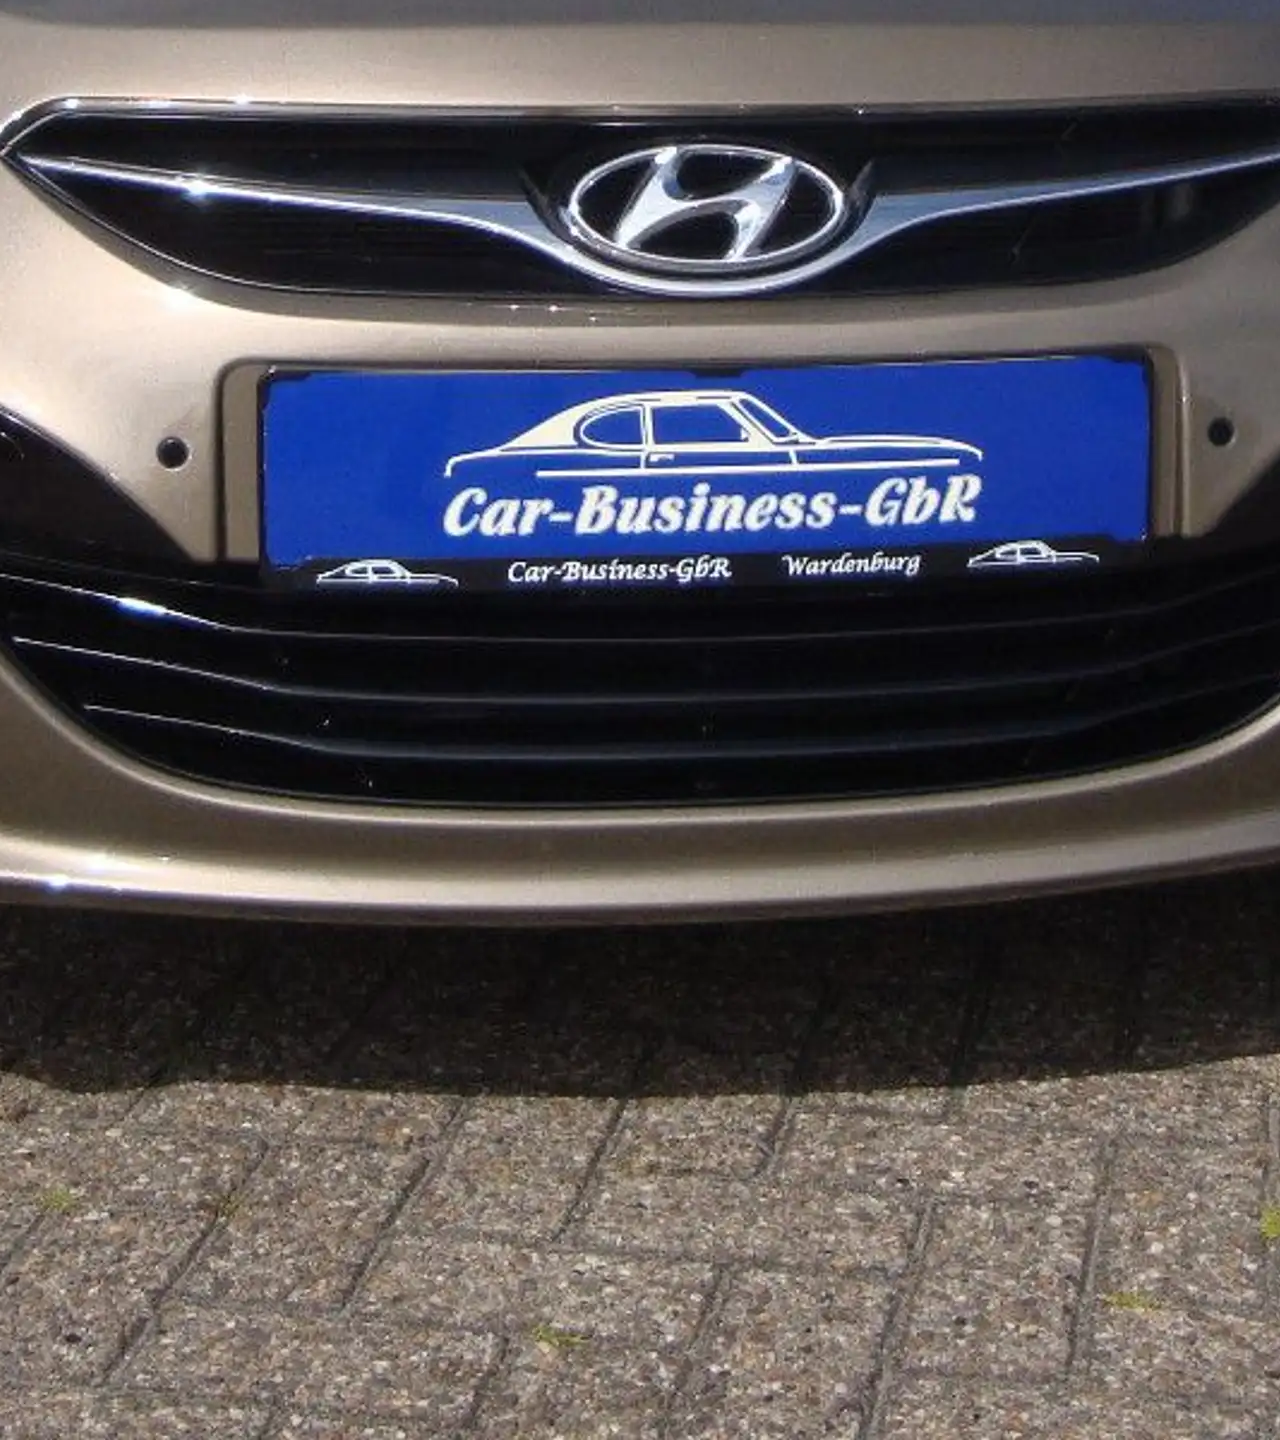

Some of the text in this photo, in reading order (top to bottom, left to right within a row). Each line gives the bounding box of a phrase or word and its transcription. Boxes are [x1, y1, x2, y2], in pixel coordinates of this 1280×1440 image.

[442, 473, 983, 537] Car-Business-GbR
[507, 551, 923, 583] Car-Business-GbR Wardenburg
